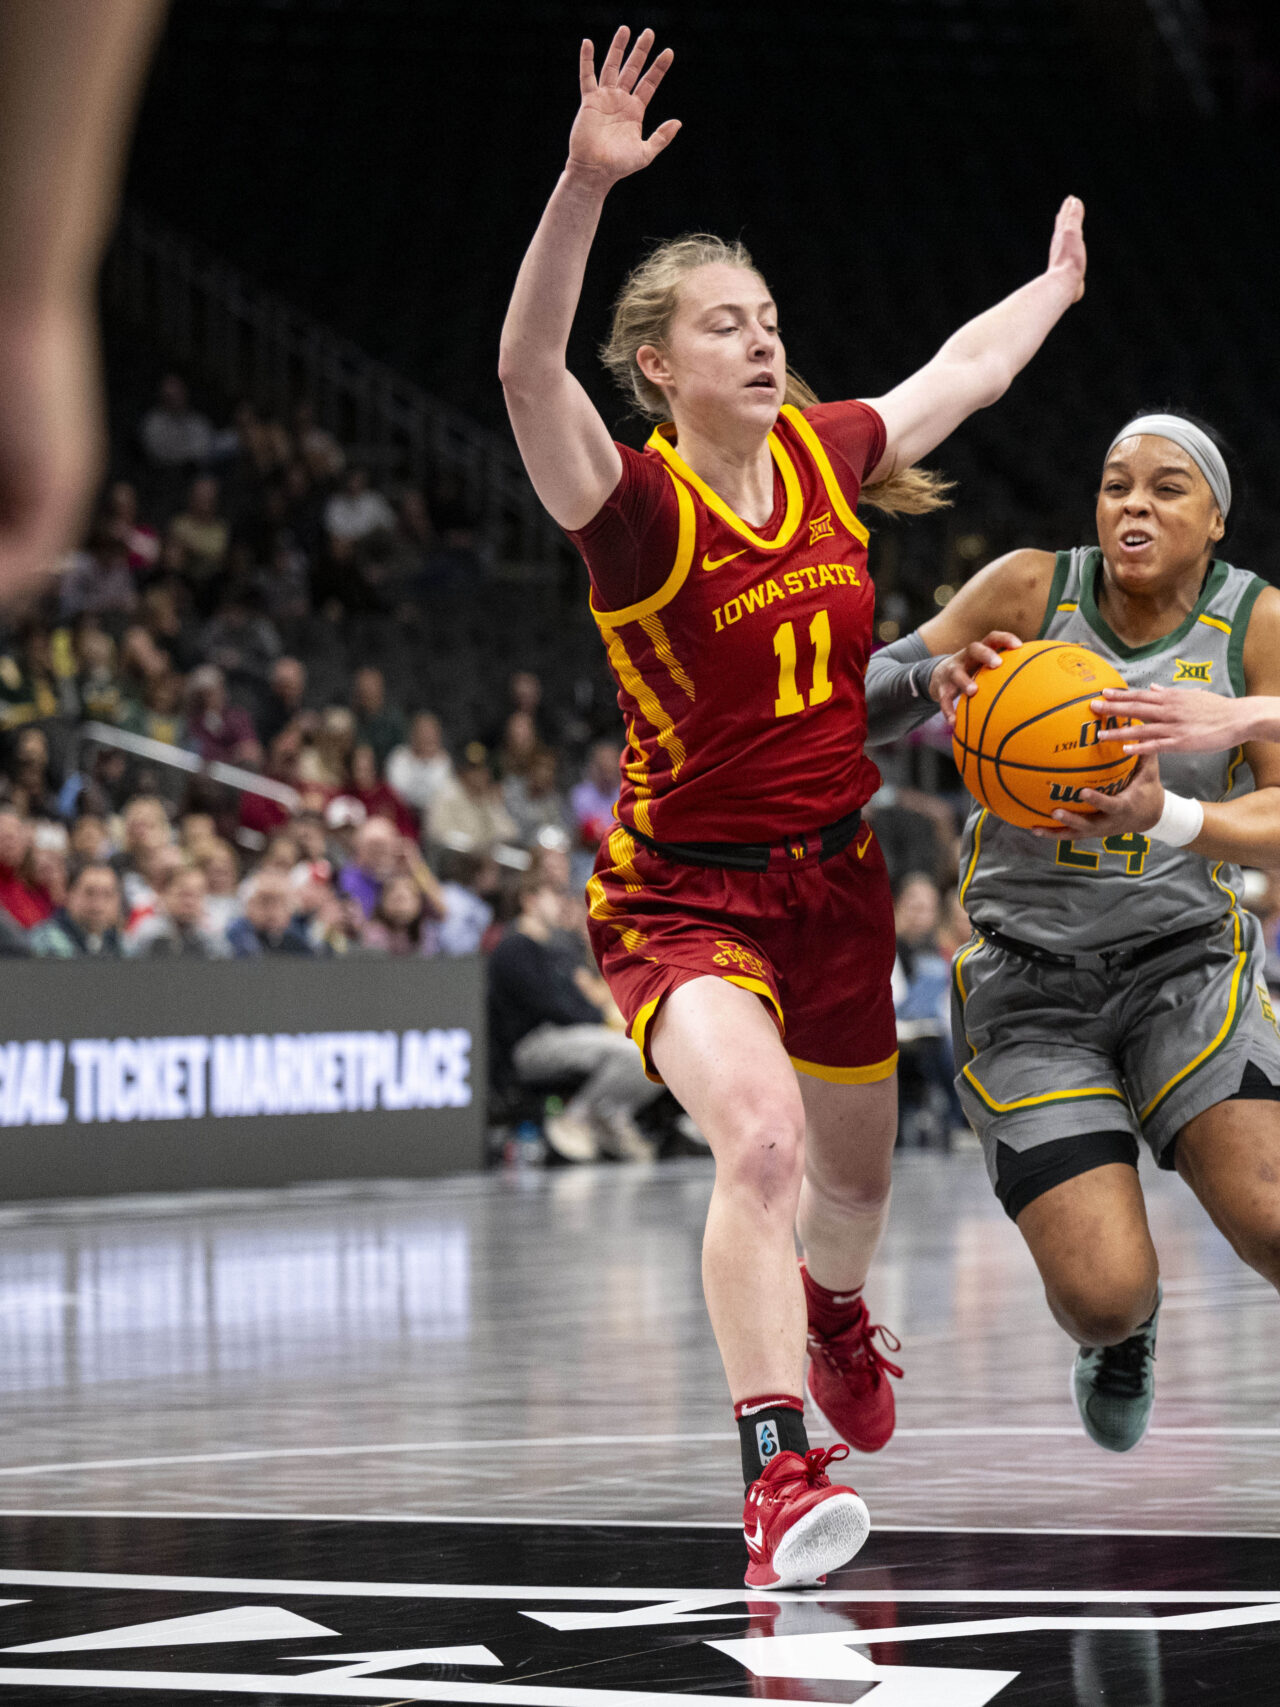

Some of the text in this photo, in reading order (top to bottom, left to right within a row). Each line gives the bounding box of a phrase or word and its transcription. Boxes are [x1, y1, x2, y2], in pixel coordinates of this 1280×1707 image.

[711, 563, 861, 633] IOWA STATE
[773, 609, 833, 718] 11
[1175, 661, 1211, 682] XII
[69, 1036, 209, 1123] TICKET
[210, 1029, 472, 1118] MARKETPLACE
